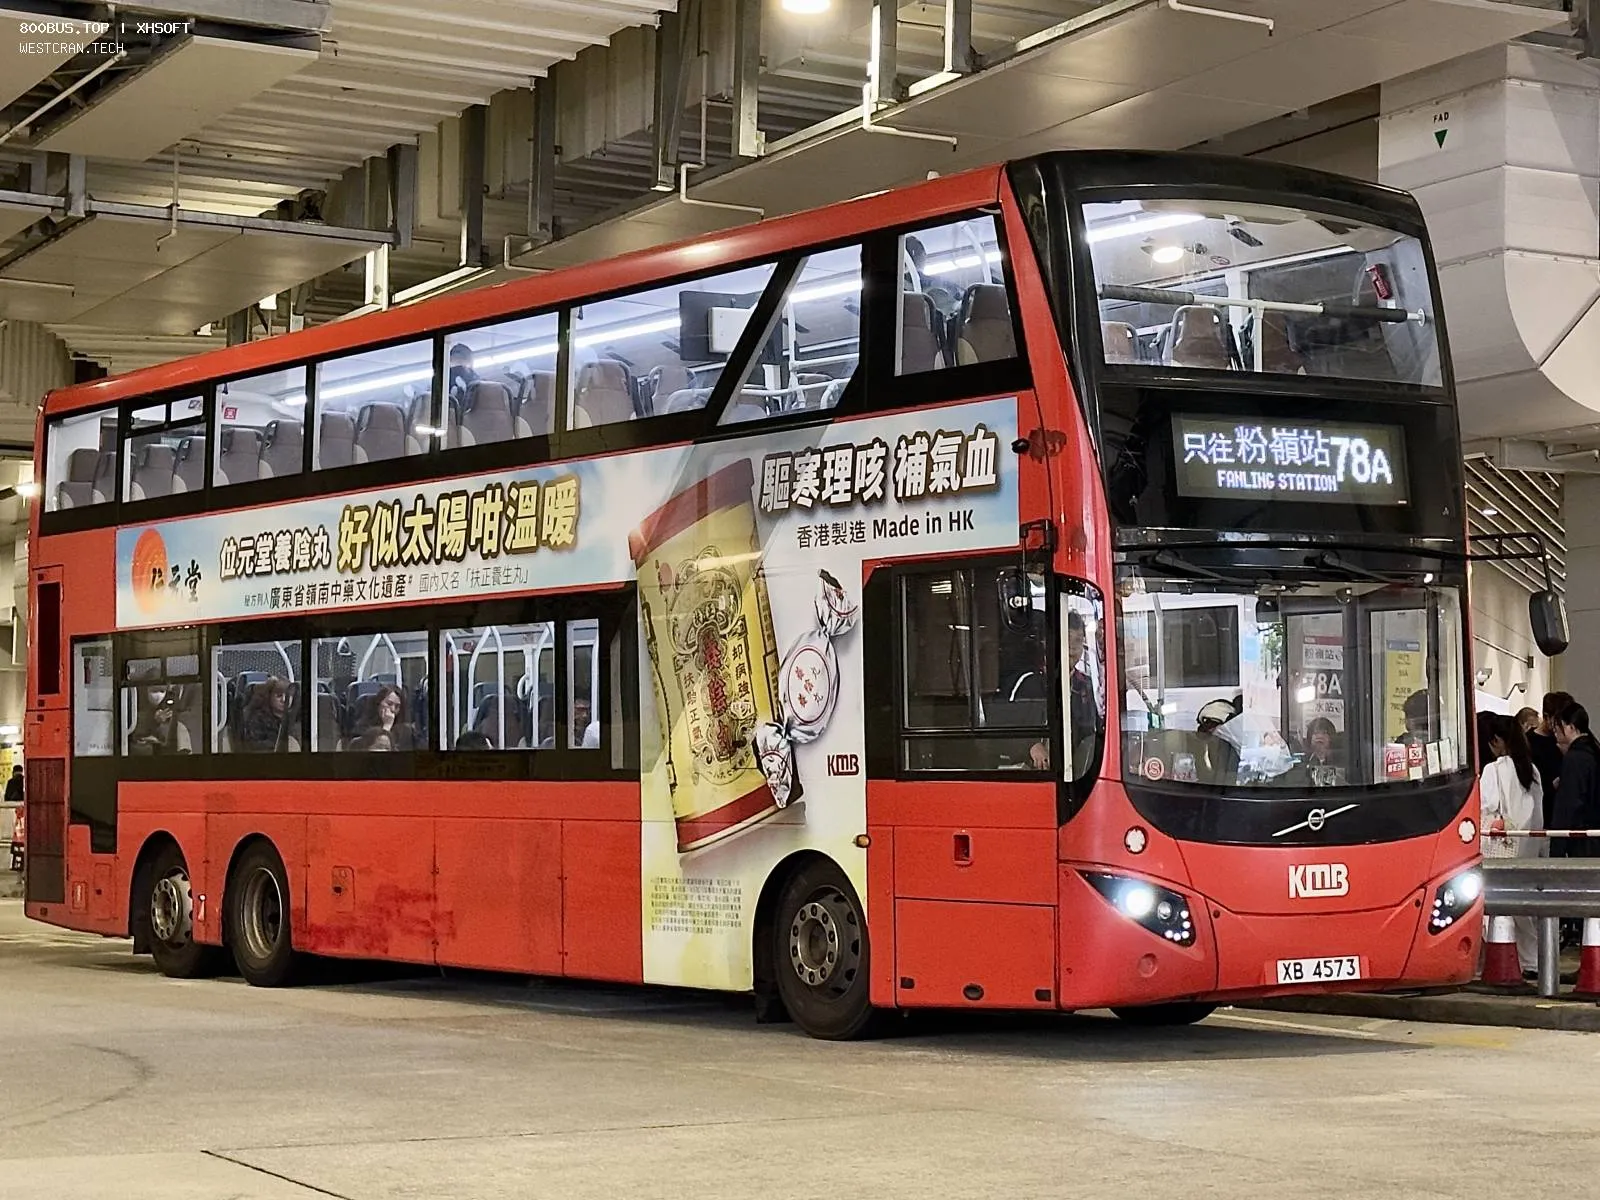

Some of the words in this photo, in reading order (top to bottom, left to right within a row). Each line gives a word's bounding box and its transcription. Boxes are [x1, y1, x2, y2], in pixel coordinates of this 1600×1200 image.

[1433, 111, 1449, 124] FAD
[760, 436, 889, 514] 驅寒理咳
[895, 422, 1000, 501] 補氣血
[1183, 425, 1331, 468] 只往粉嶺站
[1330, 436, 1393, 485] 78A
[1217, 469, 1275, 489] FANLING
[1278, 472, 1339, 492] STATION
[219, 524, 332, 580] 位元堂養陰丸
[337, 474, 581, 574] 好似太陽咁溫暖
[797, 519, 866, 549] 香港製造
[872, 511, 920, 540] Made
[925, 511, 942, 534] in
[948, 508, 975, 532] HK
[1304, 672, 1342, 695] 78A
[827, 754, 860, 777] KMB
[1287, 863, 1350, 899] KMB
[1282, 961, 1304, 981] XB
[1312, 958, 1356, 979] 4573
